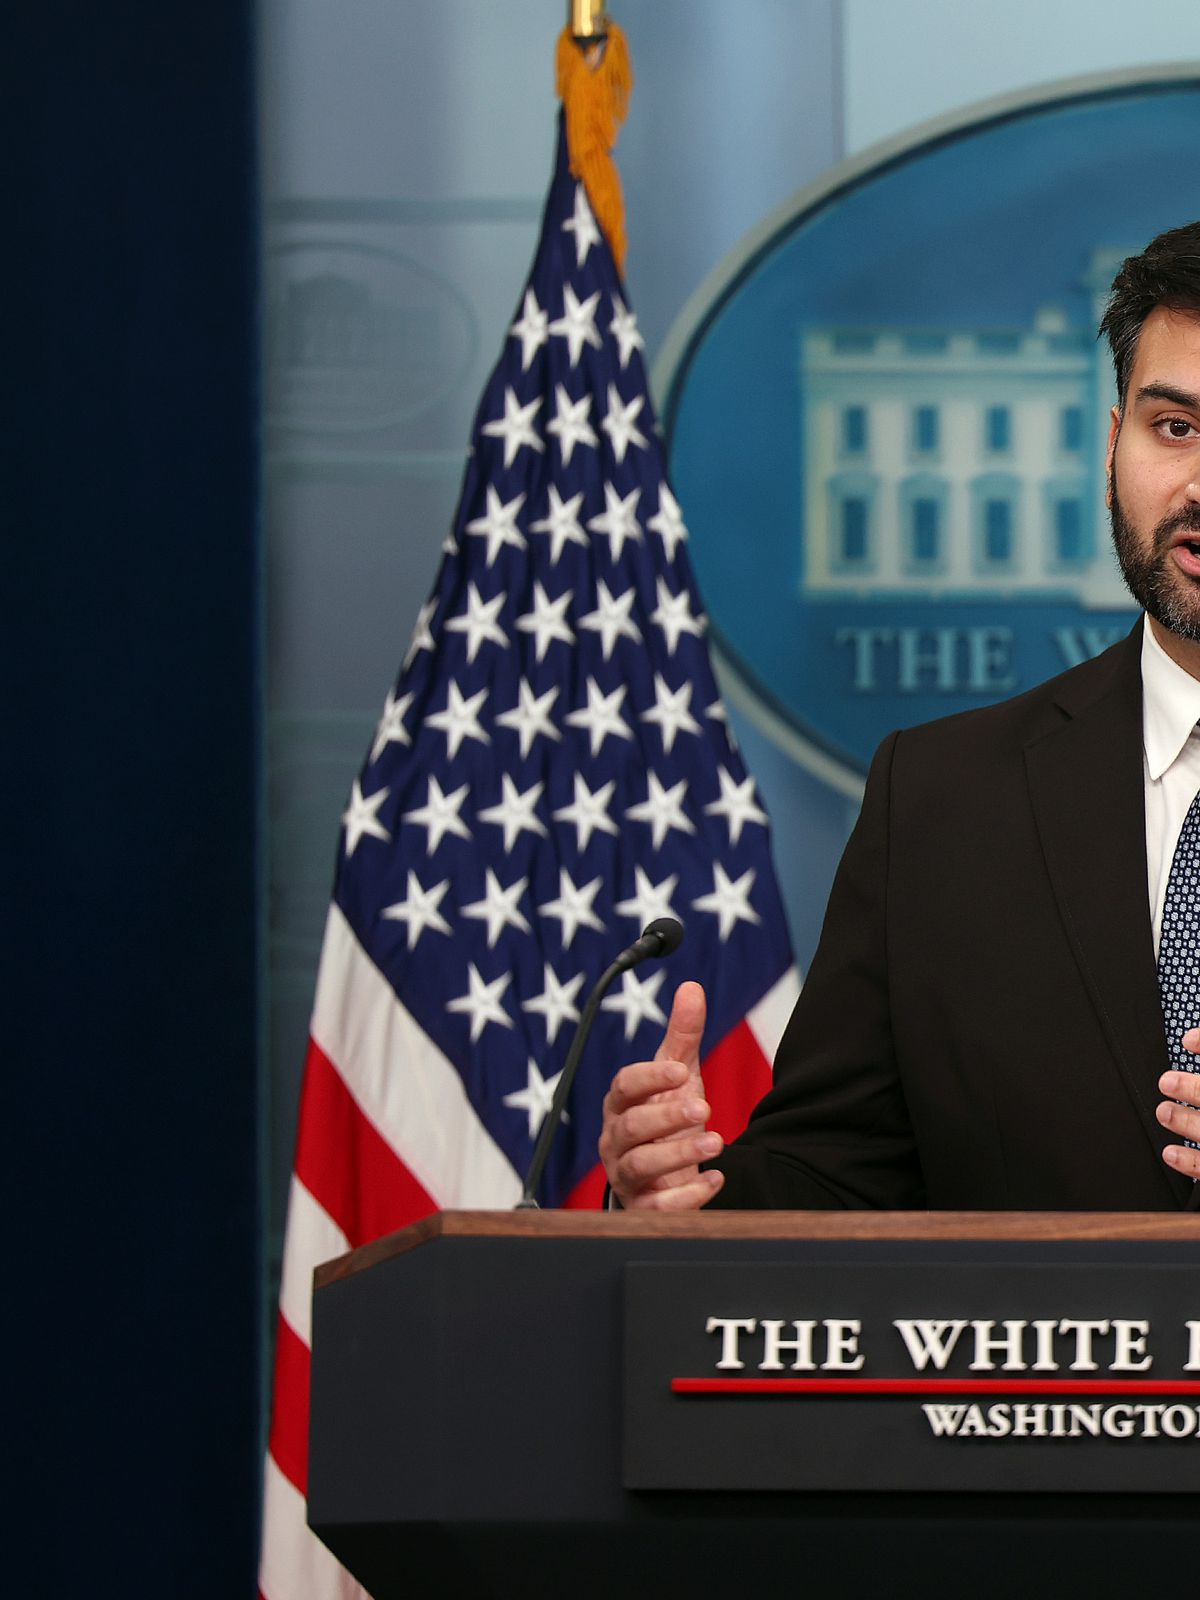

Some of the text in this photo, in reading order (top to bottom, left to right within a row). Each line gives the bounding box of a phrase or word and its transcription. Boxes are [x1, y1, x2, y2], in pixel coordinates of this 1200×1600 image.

[836, 626, 1018, 692] THE
[705, 1315, 865, 1371] THE
[892, 1318, 1153, 1372] WHITE
